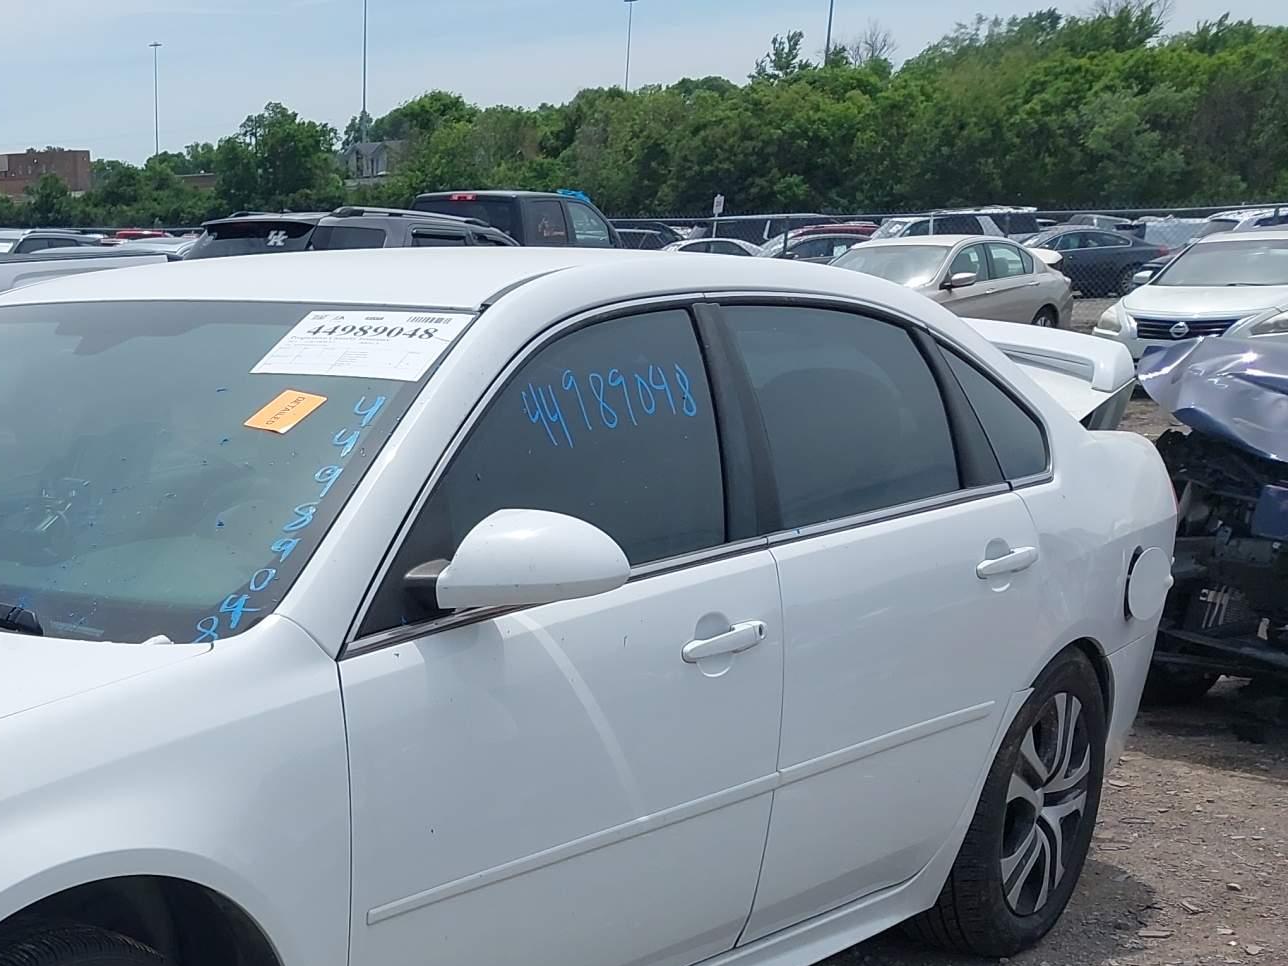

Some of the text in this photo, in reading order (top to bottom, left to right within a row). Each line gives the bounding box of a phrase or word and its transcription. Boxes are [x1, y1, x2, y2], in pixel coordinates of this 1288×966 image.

[307, 324, 439, 340] 44989048
[265, 396, 306, 425] DETAILED
[521, 363, 697, 448] 44989048
[193, 394, 388, 643] 44989048
